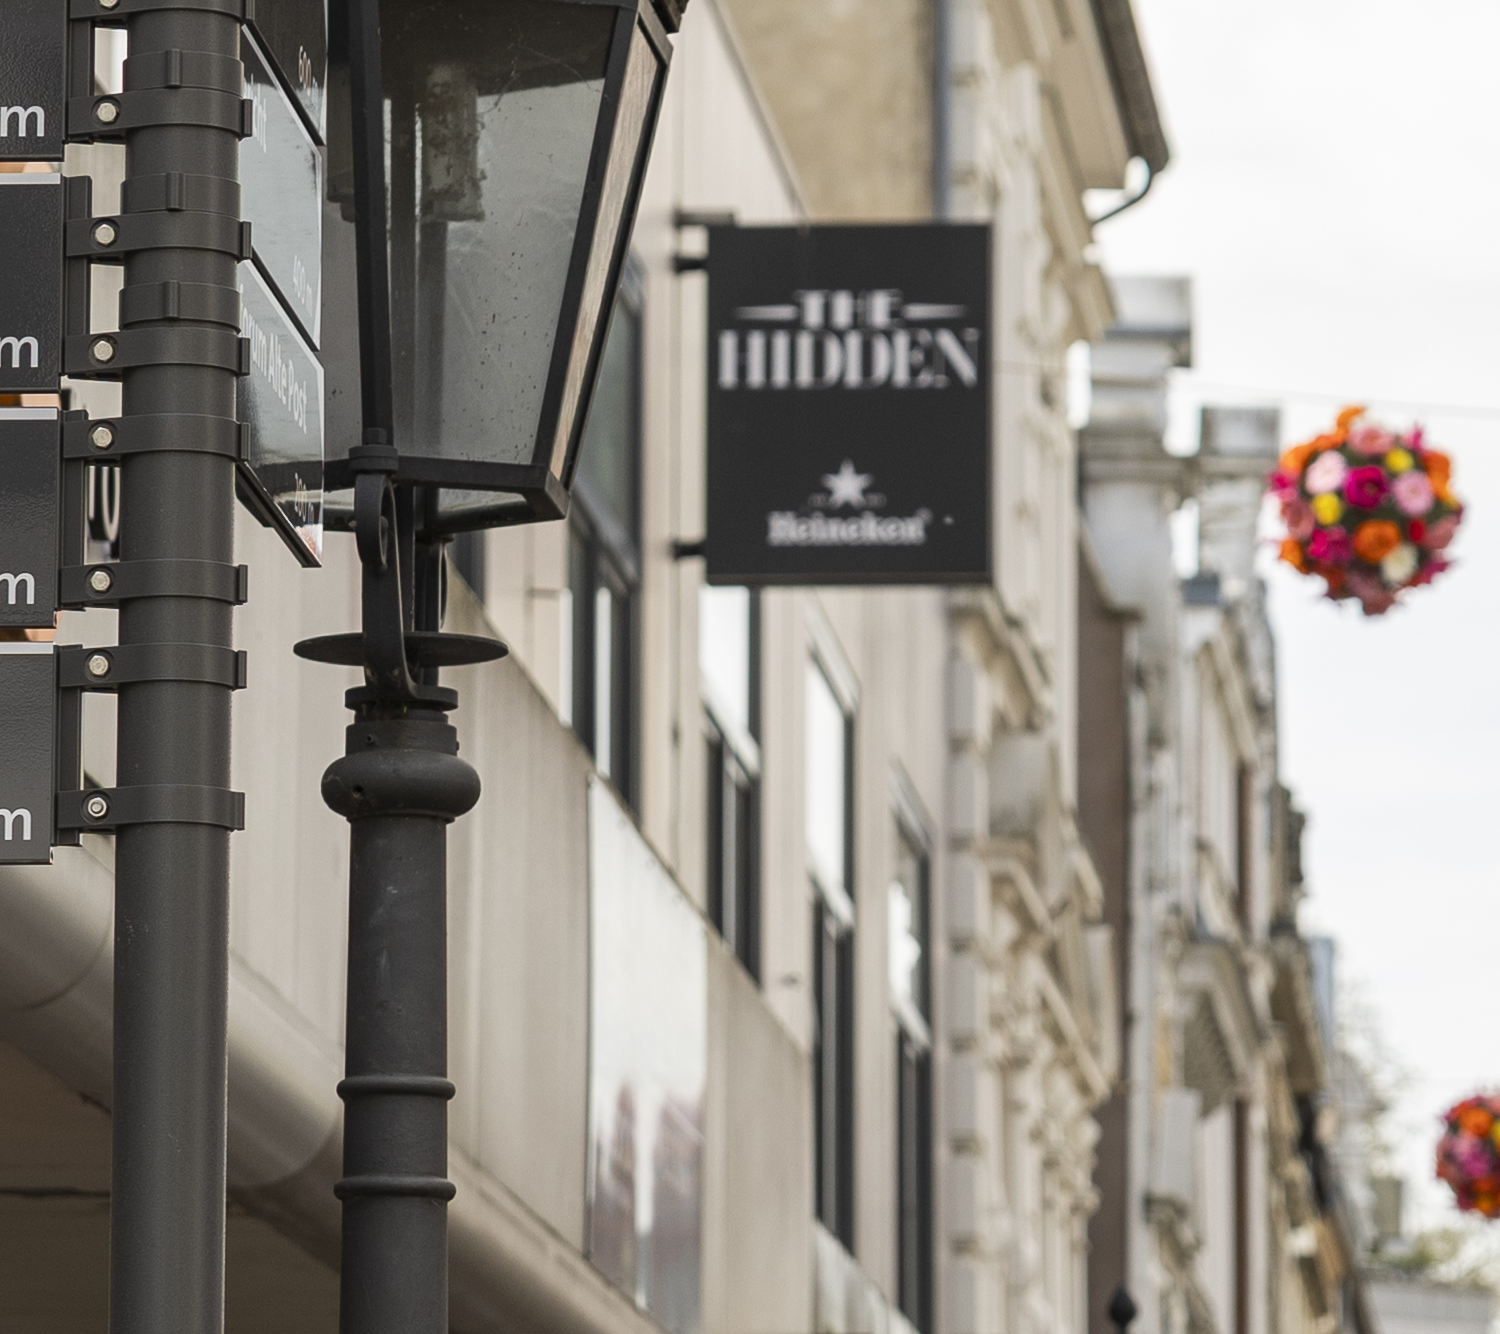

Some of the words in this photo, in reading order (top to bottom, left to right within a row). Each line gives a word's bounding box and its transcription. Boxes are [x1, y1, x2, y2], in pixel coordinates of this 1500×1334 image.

[298, 45, 312, 97] 600
[292, 254, 306, 304] 400
[795, 288, 904, 330] THE
[240, 284, 267, 377] orum
[268, 332, 288, 405] Alte
[288, 358, 307, 435] Post
[716, 327, 980, 390] HIDDEN
